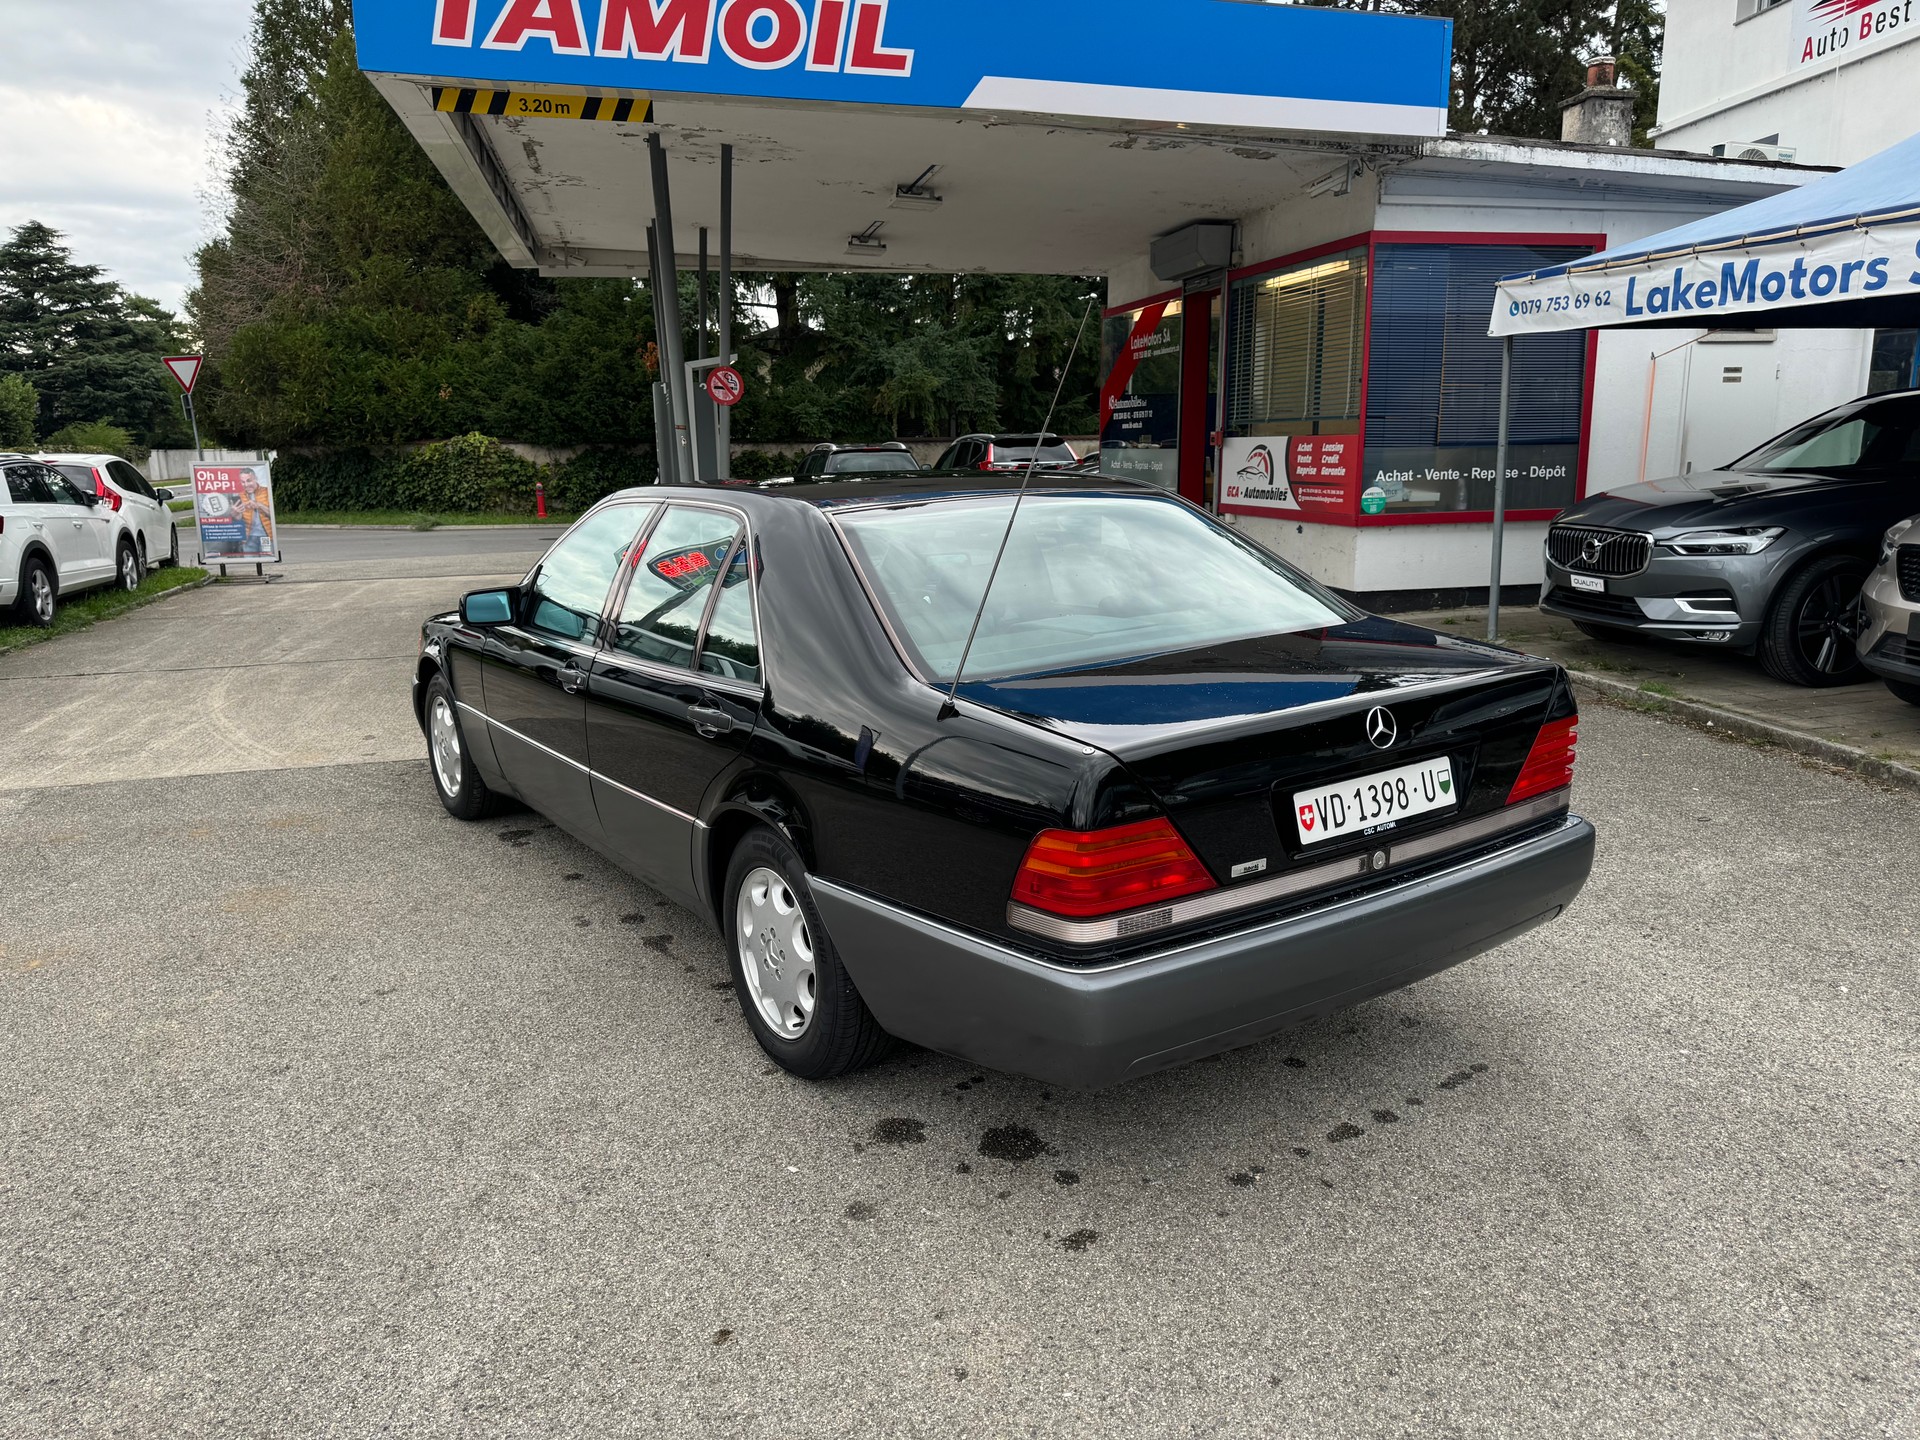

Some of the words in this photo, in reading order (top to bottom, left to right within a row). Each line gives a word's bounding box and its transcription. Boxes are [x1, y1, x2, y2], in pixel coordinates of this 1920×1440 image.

[1801, 27, 1848, 64] Auto
[1859, 0, 1912, 40] Best
[519, 98, 552, 113] 3.20
[555, 104, 570, 114] m
[1521, 299, 1542, 314] 079
[1546, 296, 1570, 312] 753
[1574, 293, 1590, 309] 69
[1595, 290, 1611, 306] 62
[1626, 257, 1890, 316] LakeMotors
[1131, 332, 1162, 350] LakeMotors
[1163, 328, 1170, 342] SA
[1297, 443, 1312, 452] Achat
[1322, 442, 1344, 453] Leasing
[1297, 455, 1312, 463] Vente
[197, 471, 214, 480] Oh
[218, 471, 228, 480] la
[1296, 466, 1317, 476] Reprise
[1321, 466, 1346, 476] Garantie
[1376, 470, 1413, 482] Achat
[1425, 469, 1460, 480] Vente
[1472, 467, 1518, 481] Repse
[1530, 465, 1566, 480] Dépôt
[1227, 486, 1239, 498] GCA
[1244, 487, 1287, 501] Automobiles
[1574, 578, 1598, 588] QUALITY
[1364, 828, 1375, 836] CSC
